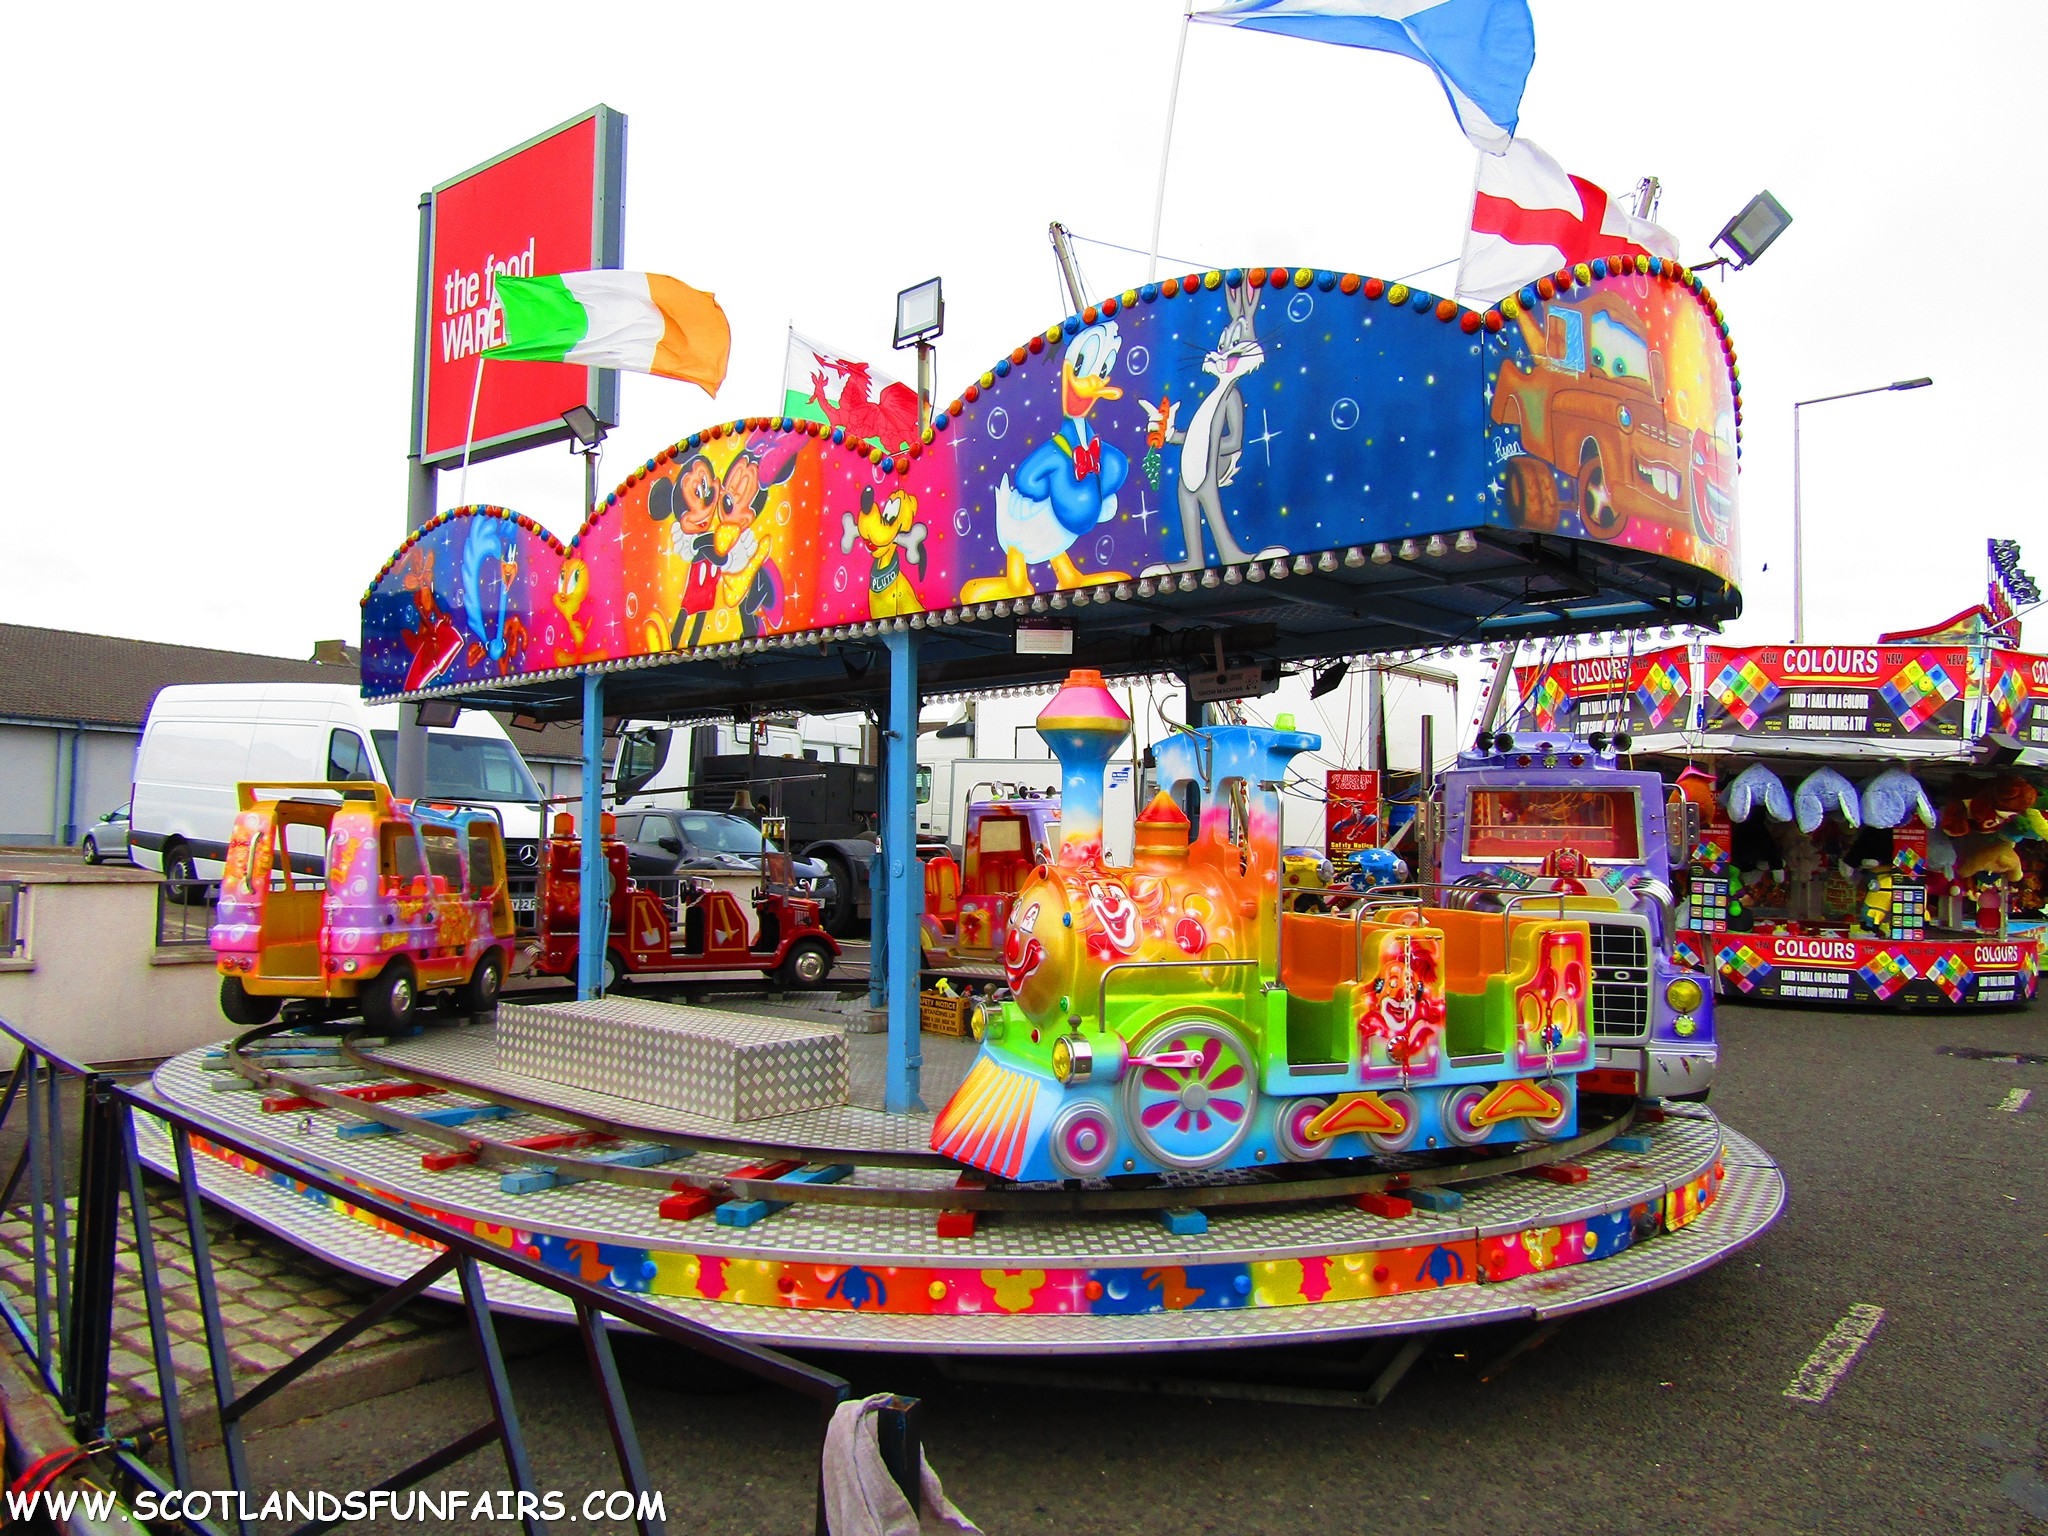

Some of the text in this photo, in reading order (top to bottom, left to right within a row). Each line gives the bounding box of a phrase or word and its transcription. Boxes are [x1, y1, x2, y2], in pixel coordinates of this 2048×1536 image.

[445, 269, 480, 315] the
[442, 307, 507, 363] WARE
[1493, 436, 1524, 462] Ryan
[872, 571, 896, 590] PLUTO
[1761, 653, 1778, 664] NEW
[1783, 649, 1878, 674] COLOURS
[1886, 654, 1904, 664] NEW
[1947, 654, 1966, 665] NEW
[1571, 658, 1632, 685] COLOURS
[1217, 686, 1244, 694] MACHINE
[1790, 694, 1806, 708] LAND
[1843, 694, 1868, 709] COLOUR
[1788, 715, 1807, 730] EVERY
[1808, 716, 1831, 730] COLOUR
[1832, 716, 1848, 730] WINS
[1855, 716, 1868, 731] TOY
[1774, 939, 1856, 960] COLOURS
[1974, 946, 2018, 962] COLOURS
[935, 1000, 956, 1010] NOTICE
